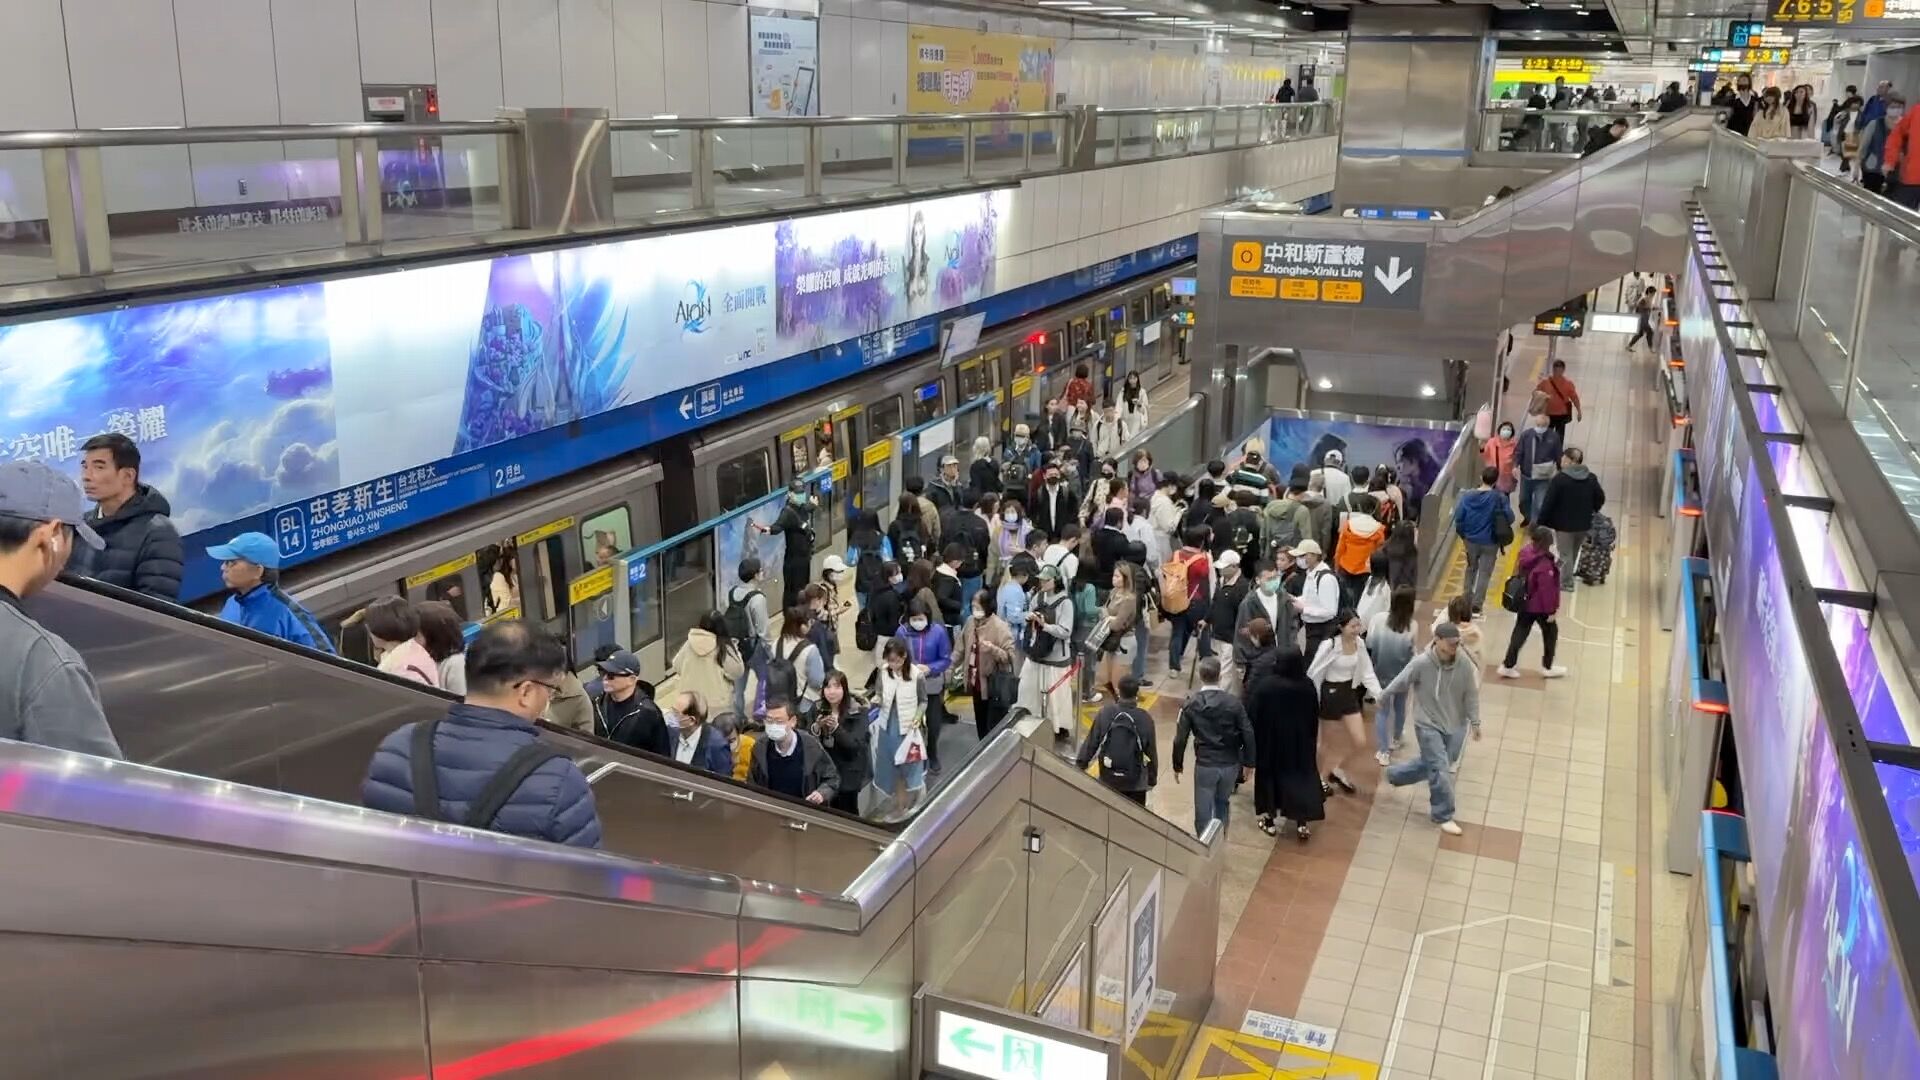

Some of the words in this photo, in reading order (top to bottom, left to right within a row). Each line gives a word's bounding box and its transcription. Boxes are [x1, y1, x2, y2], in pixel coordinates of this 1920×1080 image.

[1264, 242, 1365, 266] 中和新蘆線
[1263, 263, 1339, 277] Zhonghe-Xinlu
[1341, 266, 1364, 278] Line
[0, 405, 168, 462] 空唯一榮耀
[398, 465, 436, 488] 台北科大
[495, 468, 505, 489] 2
[505, 463, 521, 478] 月台
[310, 478, 395, 525] 忠孝新生
[280, 516, 300, 534] BL
[311, 514, 364, 539] ZHONGXIAO
[366, 500, 409, 522] XINSHENG
[282, 532, 300, 551] 14
[639, 563, 646, 577] 2
